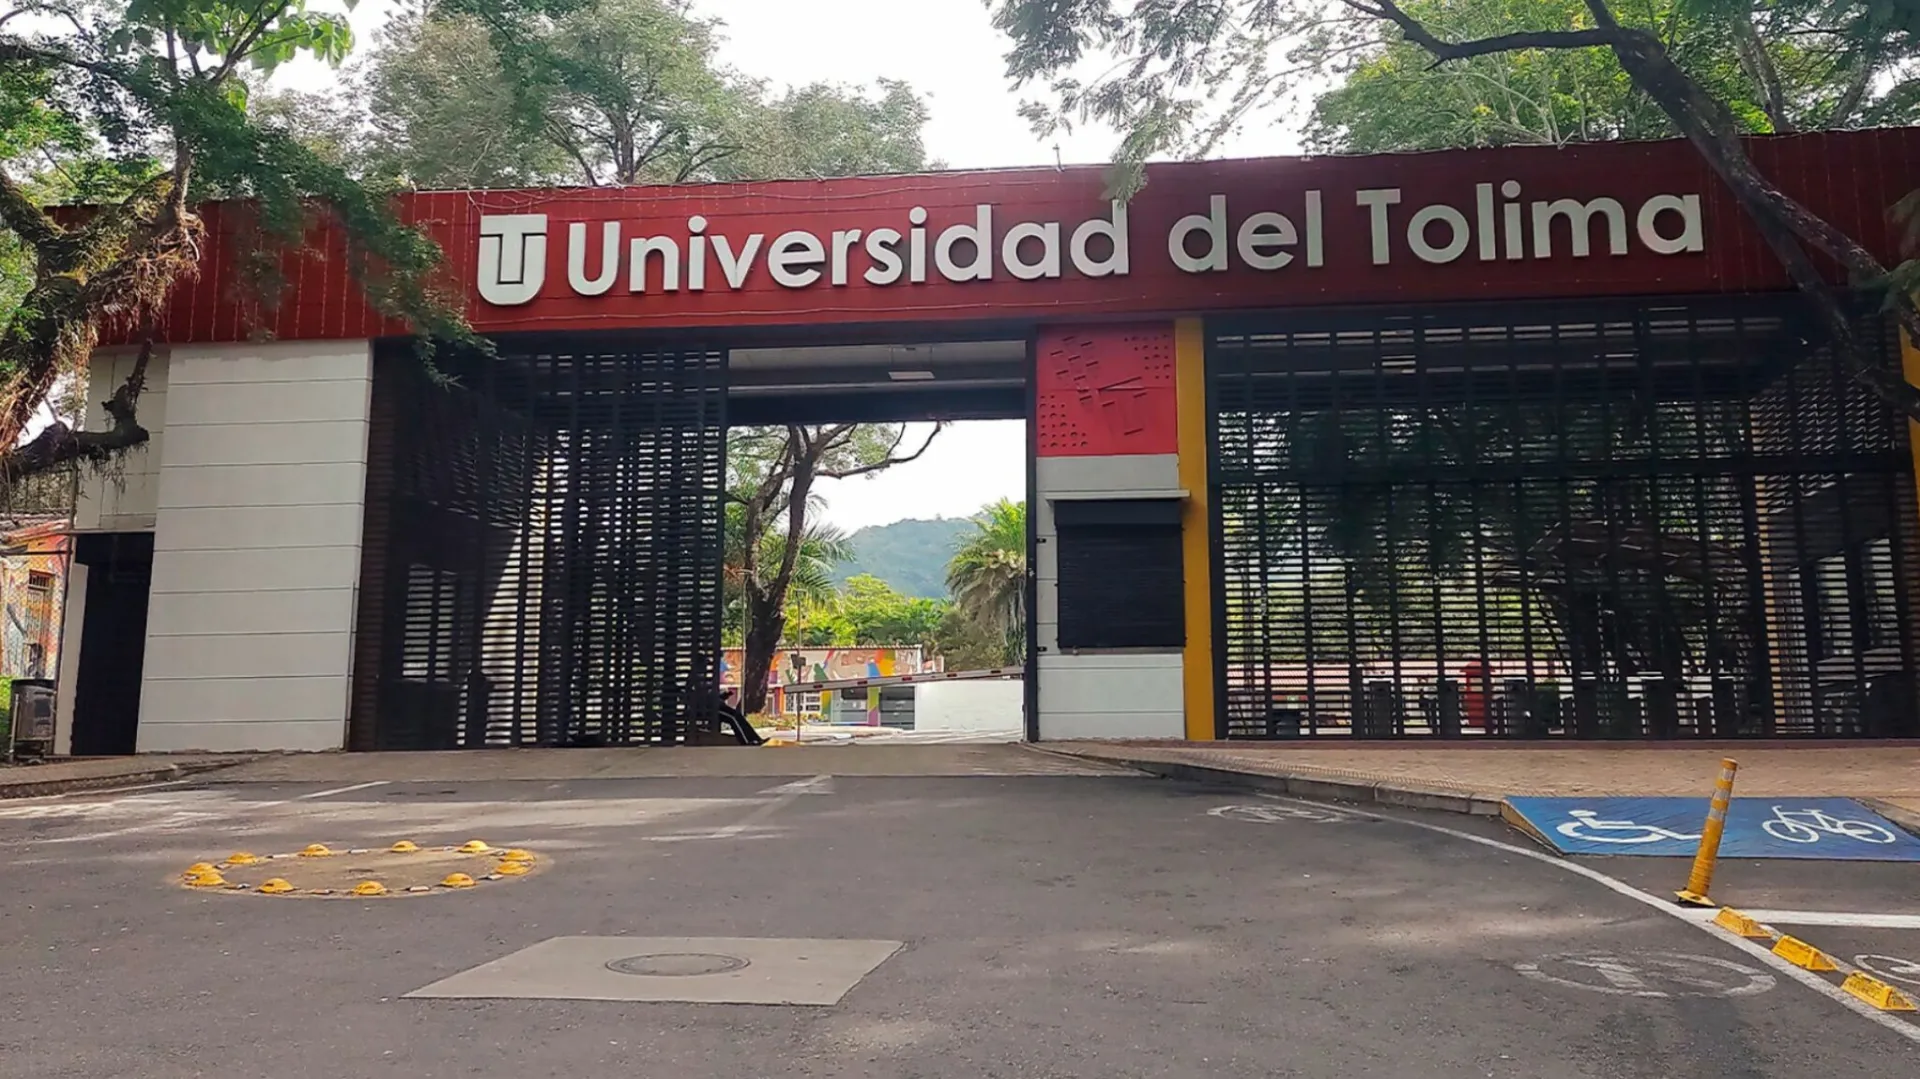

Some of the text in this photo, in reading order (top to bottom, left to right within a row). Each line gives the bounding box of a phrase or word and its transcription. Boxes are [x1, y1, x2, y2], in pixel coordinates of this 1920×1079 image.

[567, 199, 1130, 296] Universidad
[1167, 189, 1324, 274] del
[1355, 180, 1705, 264] Tolima
